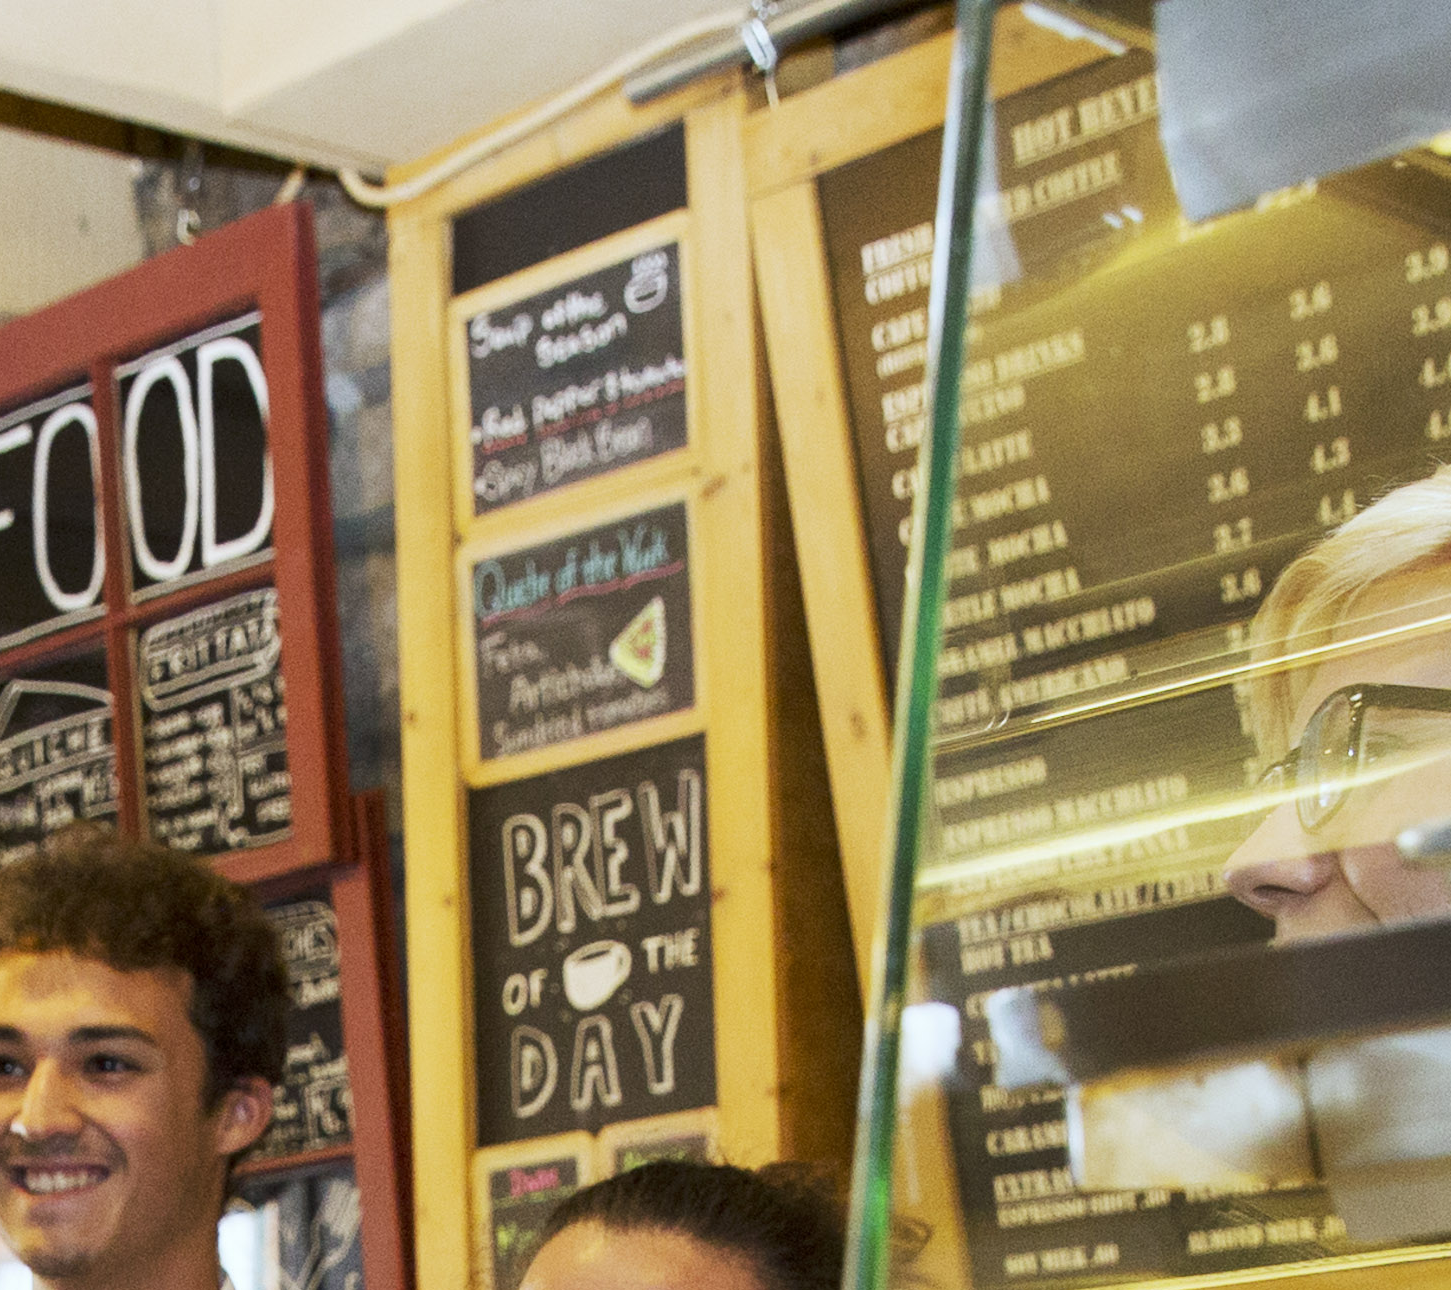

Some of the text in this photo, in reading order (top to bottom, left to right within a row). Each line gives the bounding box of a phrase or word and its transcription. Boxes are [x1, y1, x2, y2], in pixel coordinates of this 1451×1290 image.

[501, 767, 701, 948] BREW
[502, 927, 700, 1016] OF THE
[509, 993, 685, 1119] DAY
